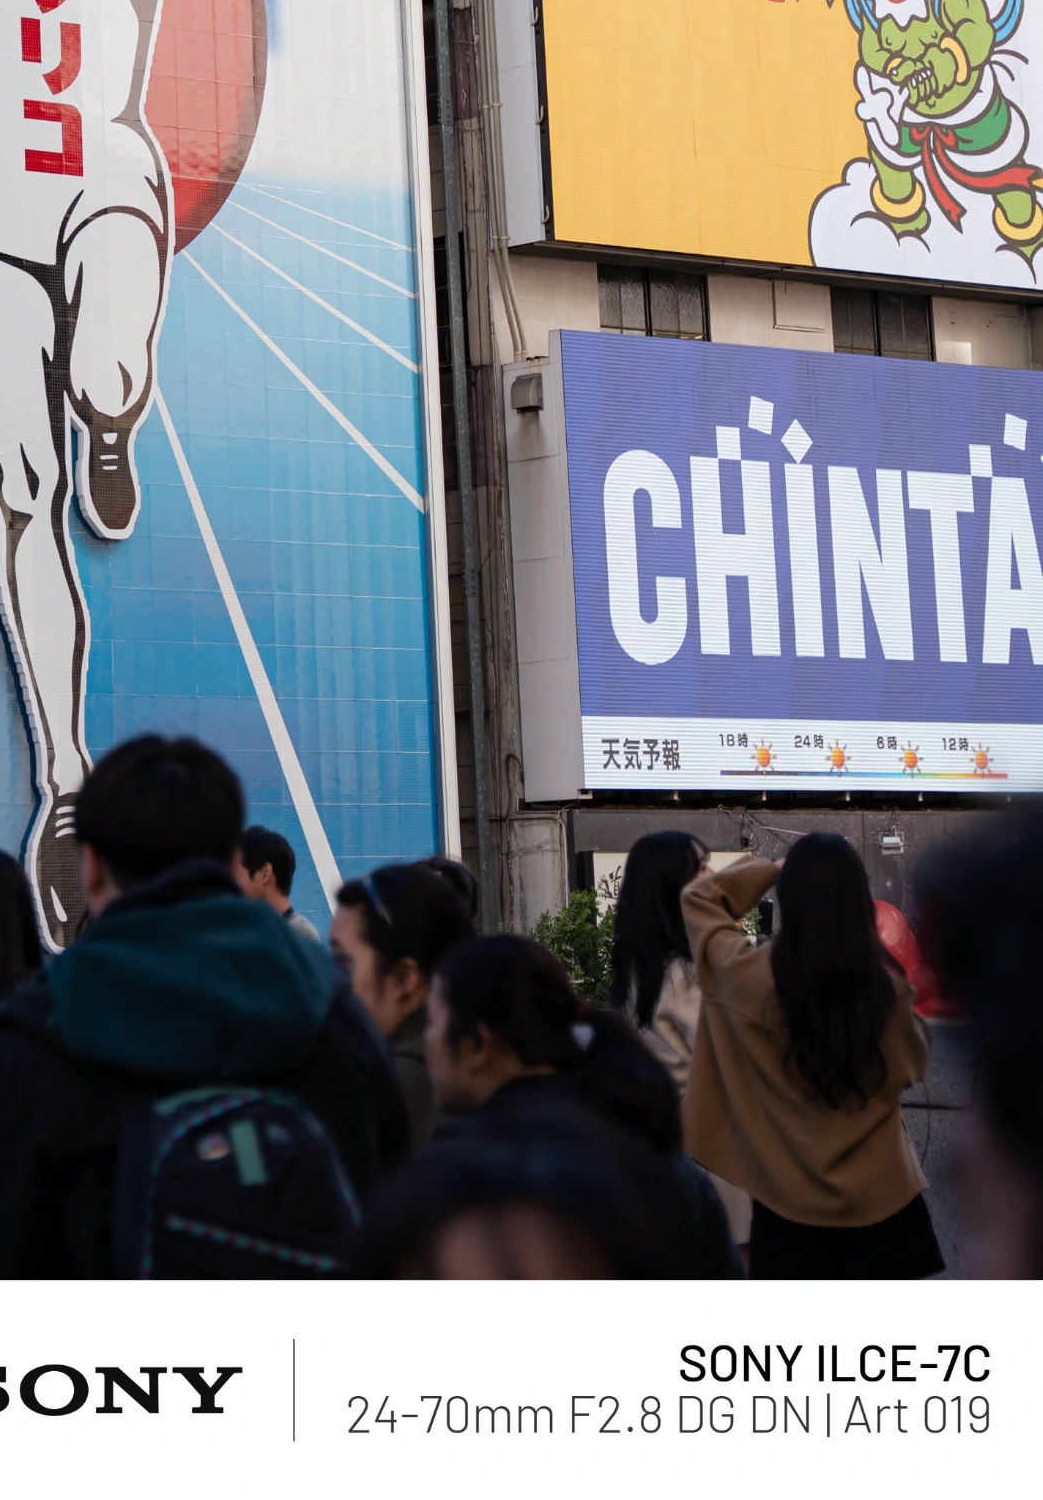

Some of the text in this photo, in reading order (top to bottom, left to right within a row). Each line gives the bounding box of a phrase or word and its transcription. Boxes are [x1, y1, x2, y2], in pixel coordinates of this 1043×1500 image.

[601, 738, 681, 771] 天気予報
[718, 732, 969, 752] 18時 24時 6時 12時
